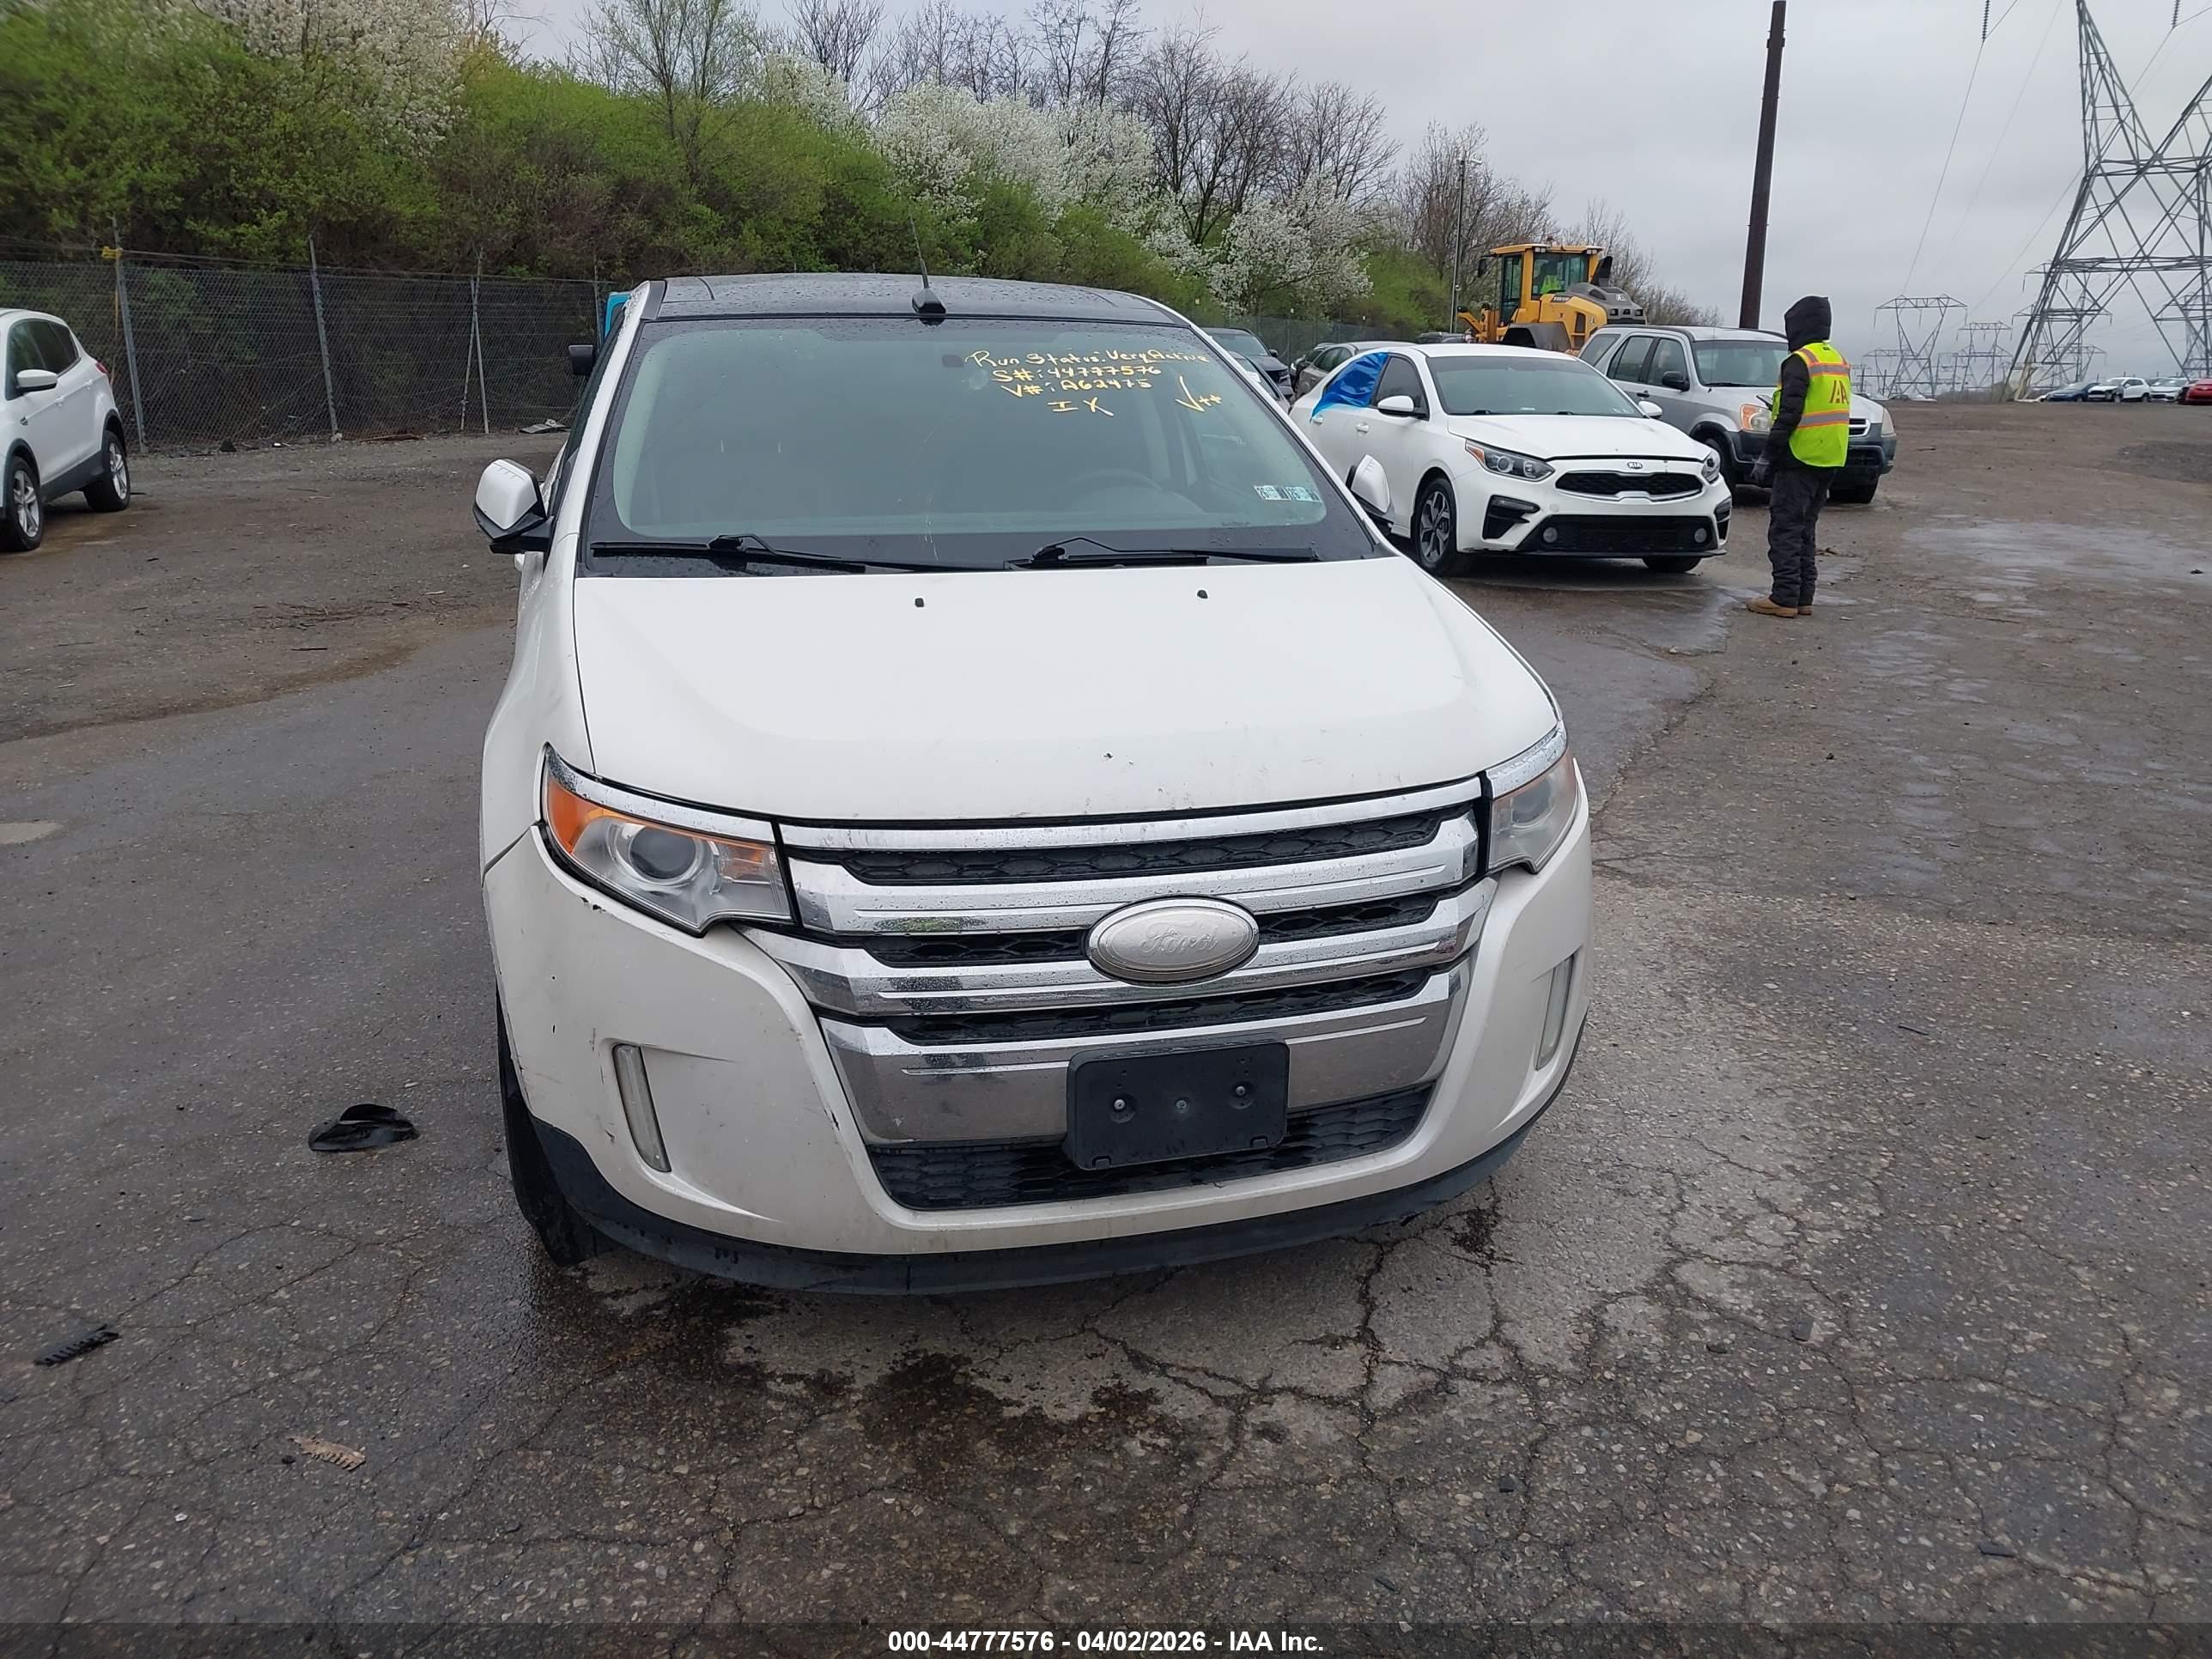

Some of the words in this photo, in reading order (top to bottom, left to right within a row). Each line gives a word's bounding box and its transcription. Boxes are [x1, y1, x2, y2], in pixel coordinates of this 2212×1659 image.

[965, 350, 1020, 367] Run
[1047, 366, 1162, 378] 44777576
[1140, 921, 1219, 957] Ford
